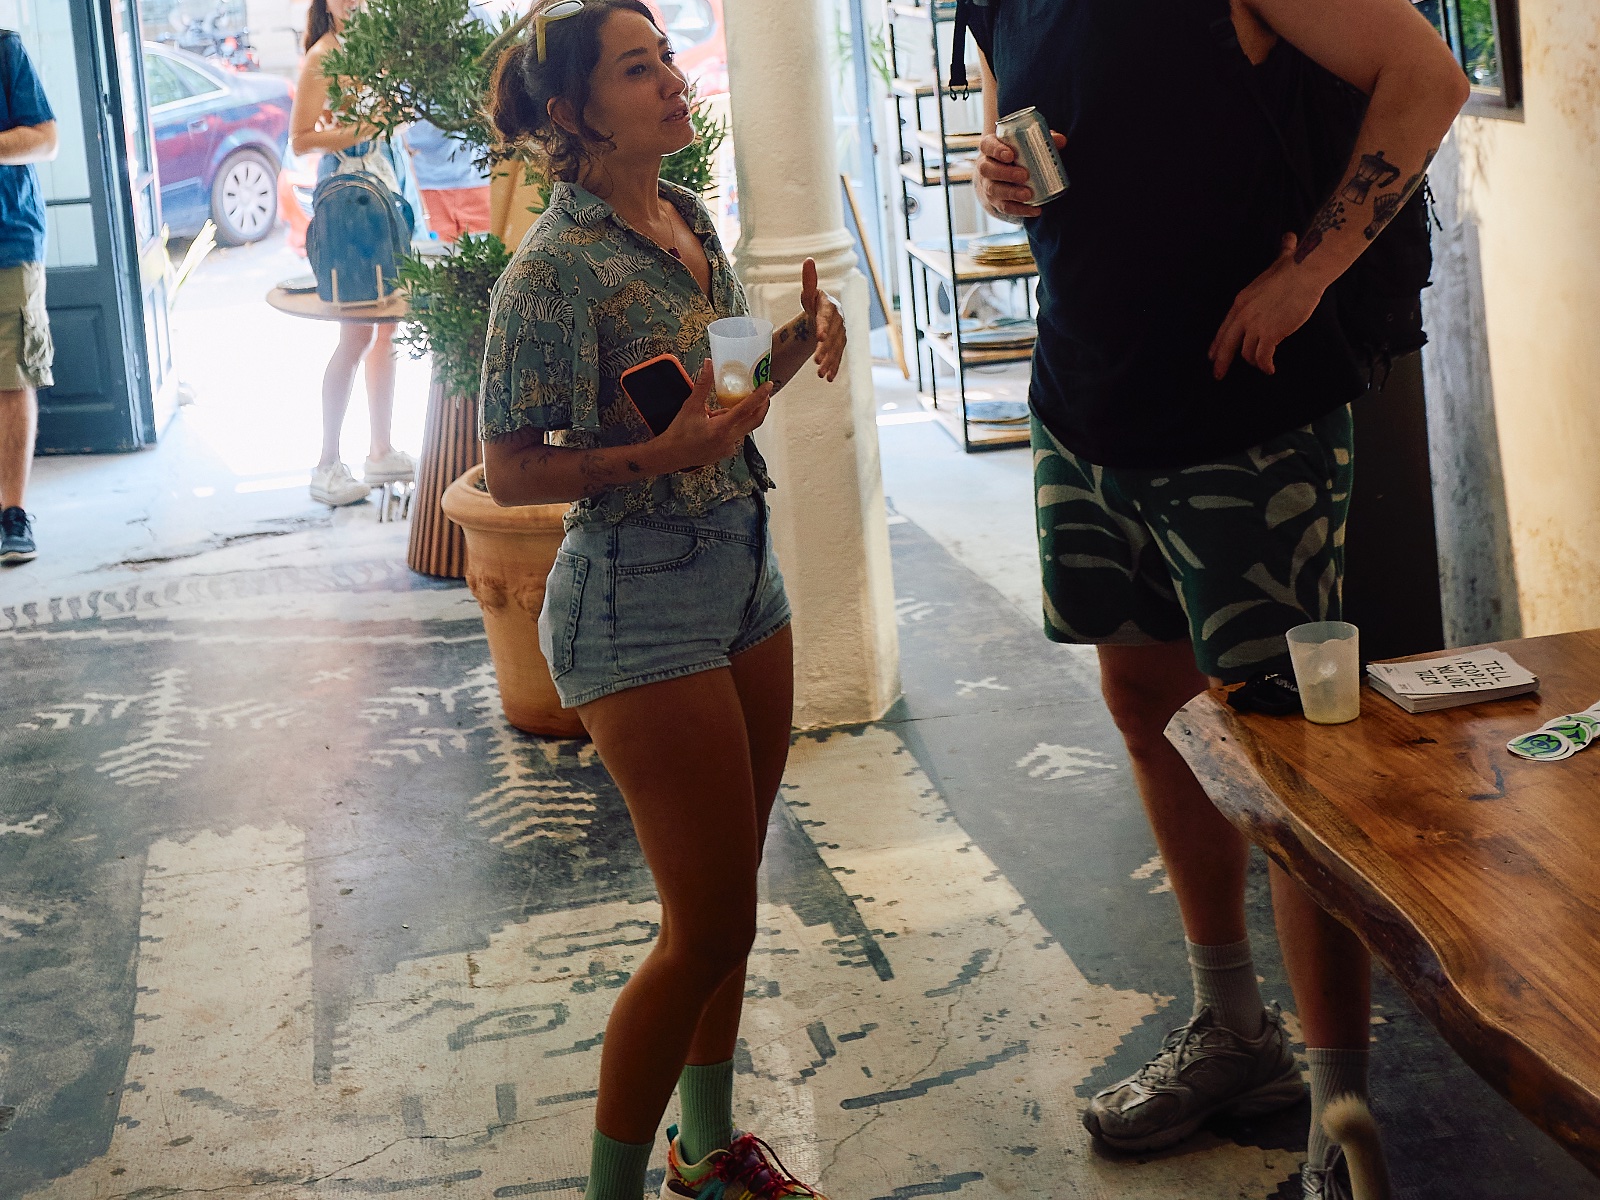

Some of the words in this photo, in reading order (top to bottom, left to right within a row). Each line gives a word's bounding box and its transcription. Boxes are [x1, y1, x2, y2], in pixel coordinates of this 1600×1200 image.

[1415, 669, 1443, 686] THEM
[1455, 661, 1494, 688] PEOPLE
[1481, 660, 1512, 682] TELL
